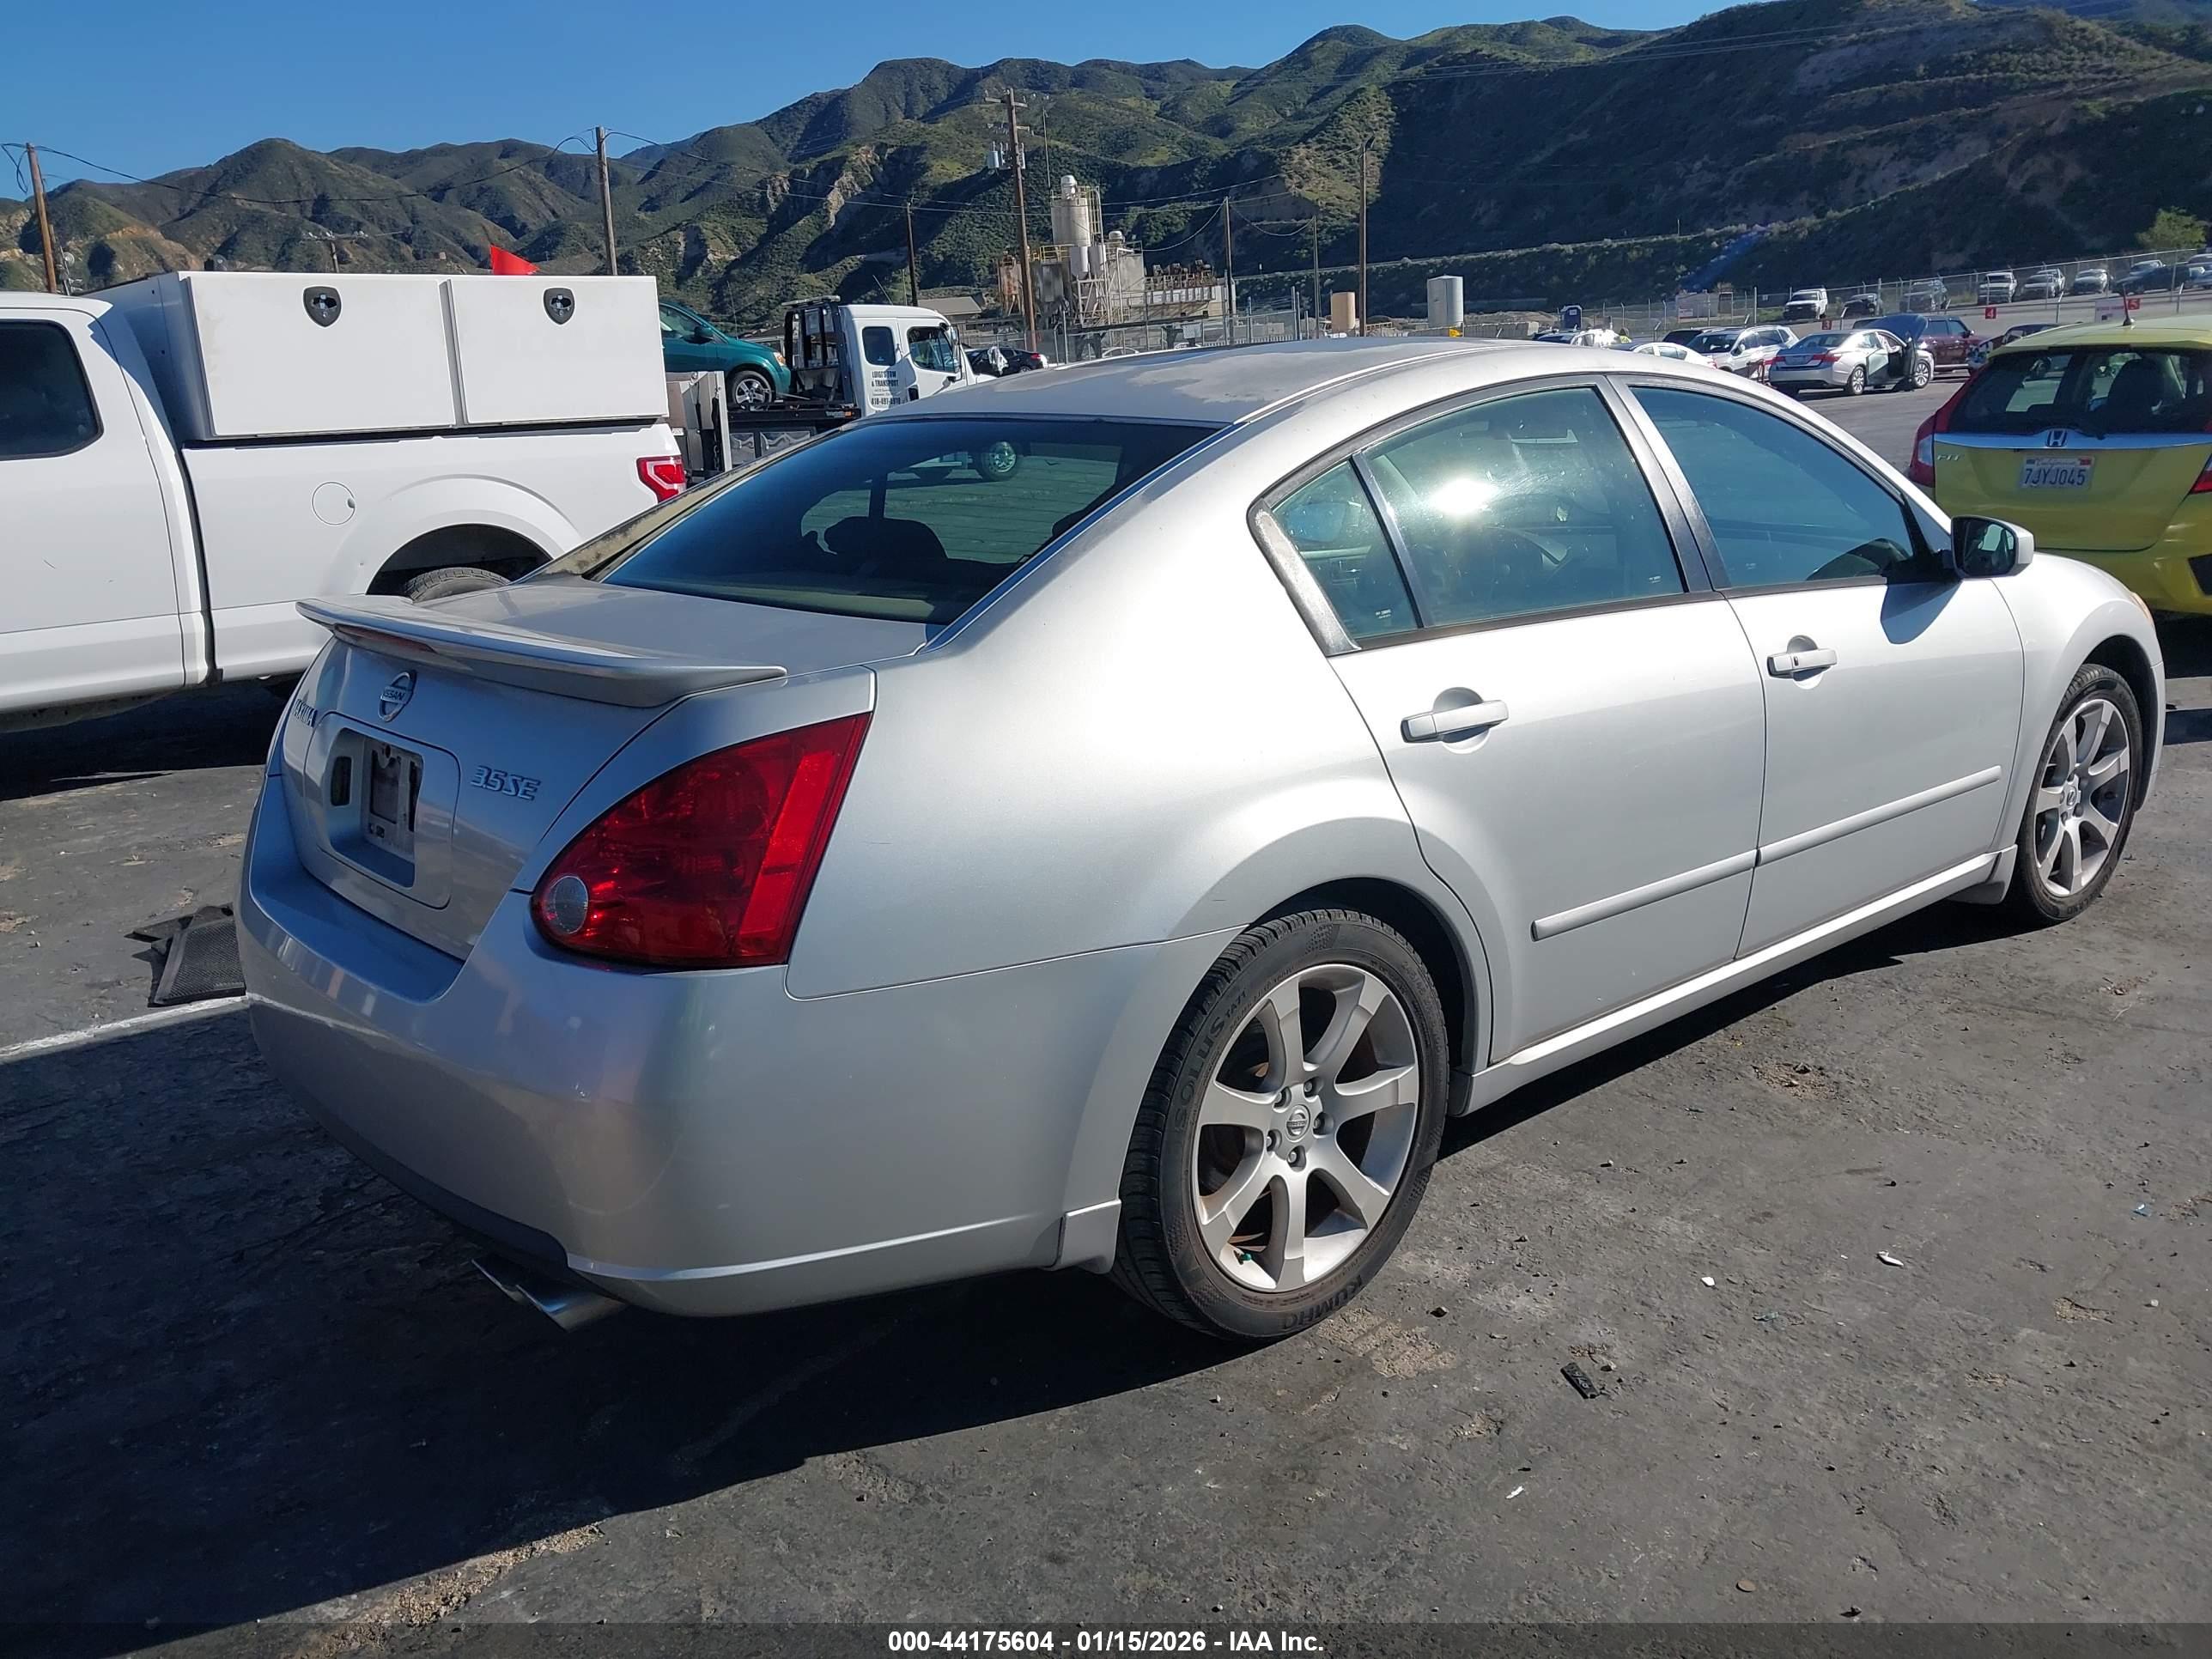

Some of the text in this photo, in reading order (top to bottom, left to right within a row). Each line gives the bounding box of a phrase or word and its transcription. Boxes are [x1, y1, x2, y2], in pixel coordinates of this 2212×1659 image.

[887, 370, 896, 379] TOW
[2025, 467, 2087, 486] 7JYJ045
[1175, 1016, 1225, 1133] SOLUS
[1283, 1274, 1363, 1330] KUMHO
